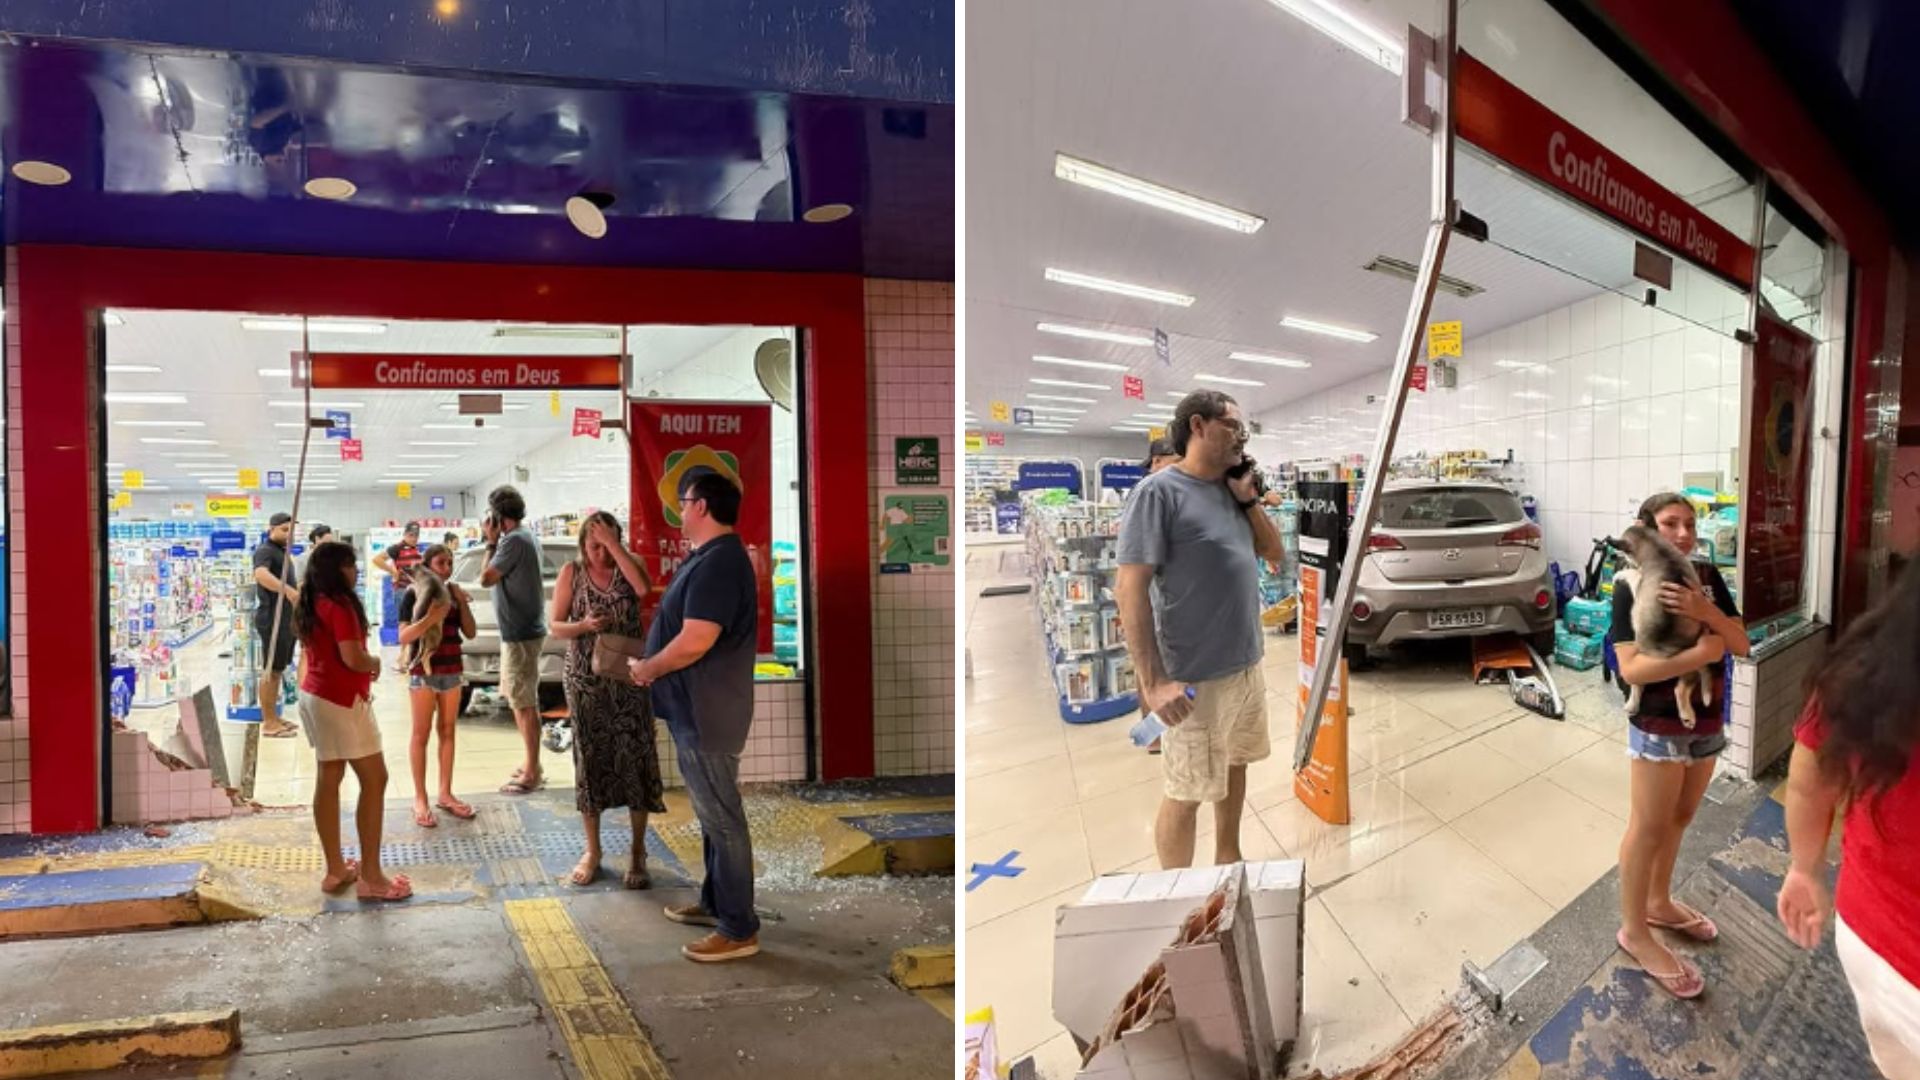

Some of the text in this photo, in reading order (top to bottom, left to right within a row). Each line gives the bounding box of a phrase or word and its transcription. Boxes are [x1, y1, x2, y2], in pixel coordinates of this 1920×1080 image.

[1548, 131, 1719, 265] Confiamos em Deus
[375, 361, 560, 384] Confiamos em Deus
[660, 414, 741, 435] AQUI TEM
